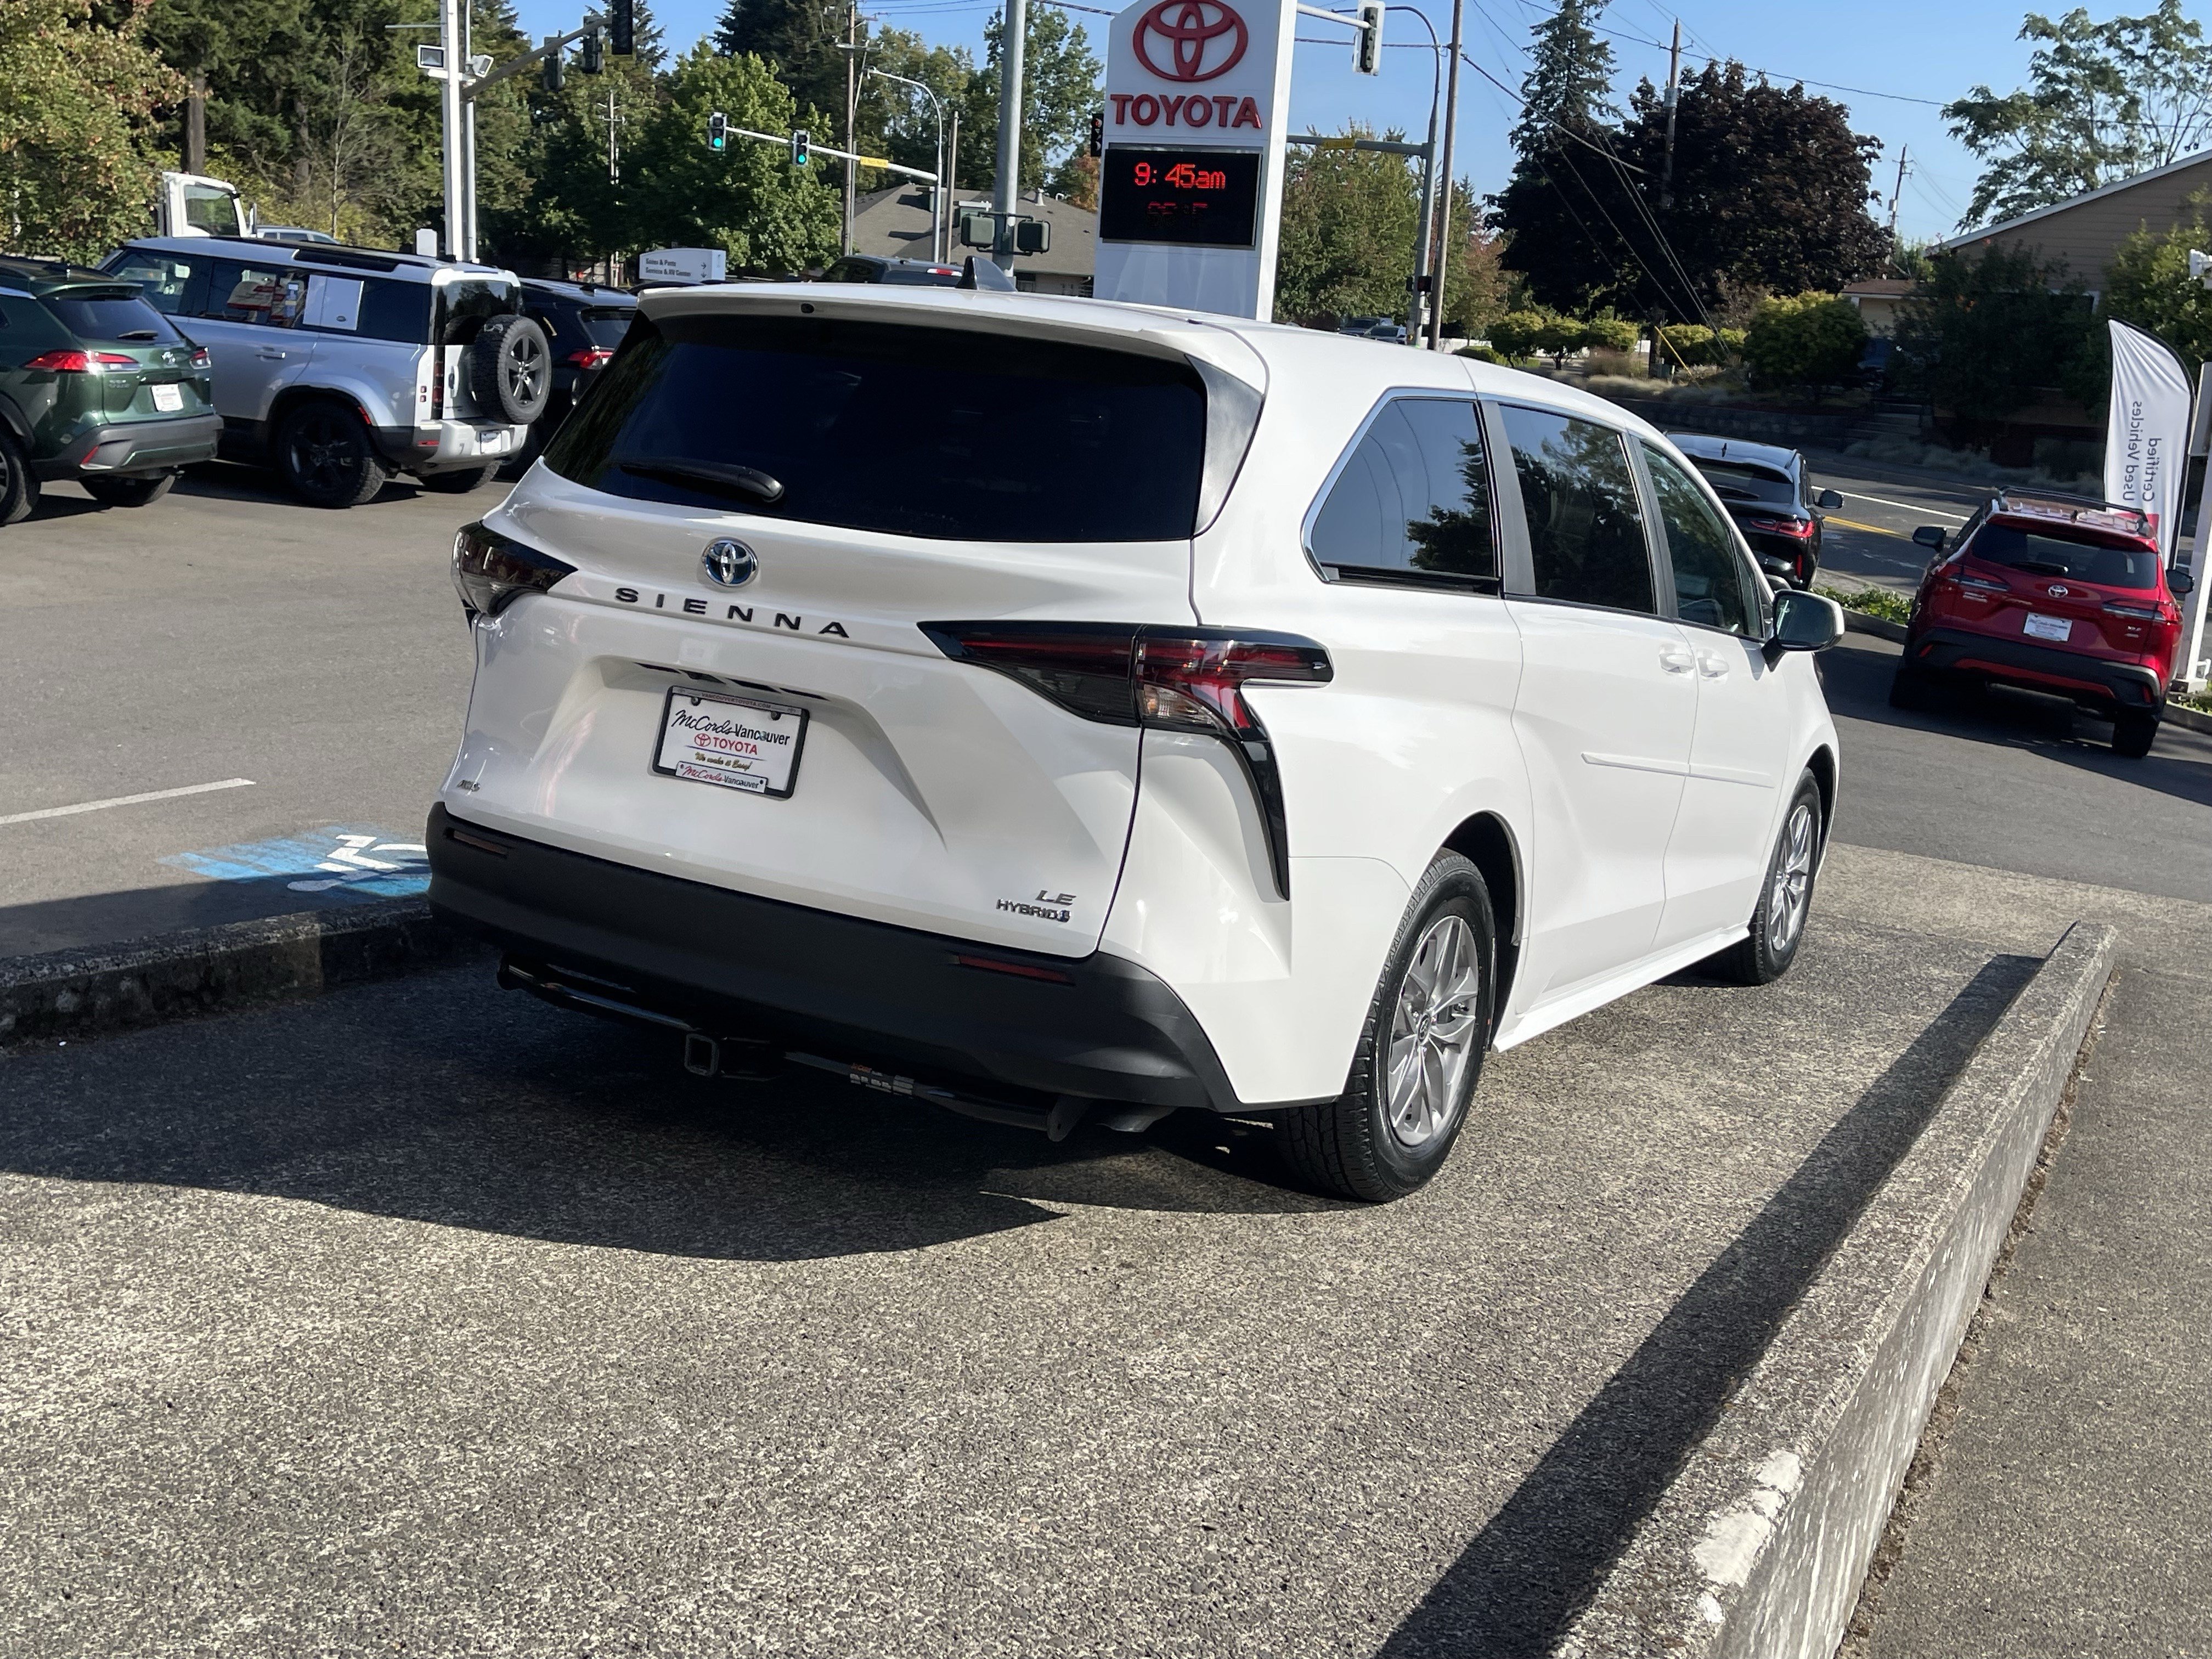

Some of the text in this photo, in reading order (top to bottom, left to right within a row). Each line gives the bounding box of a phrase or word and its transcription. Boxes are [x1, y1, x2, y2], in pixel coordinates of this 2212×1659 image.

[1110, 94, 1262, 128] TOYOTA
[1135, 162, 1226, 189] 9:45am
[616, 587, 850, 638] SIENNA
[713, 737, 758, 755] TOYOTA
[735, 723, 791, 746] Vancouver
[724, 775, 759, 789] Vancouver
[996, 898, 1059, 921] HYBRID
[1035, 890, 1076, 906] LE
